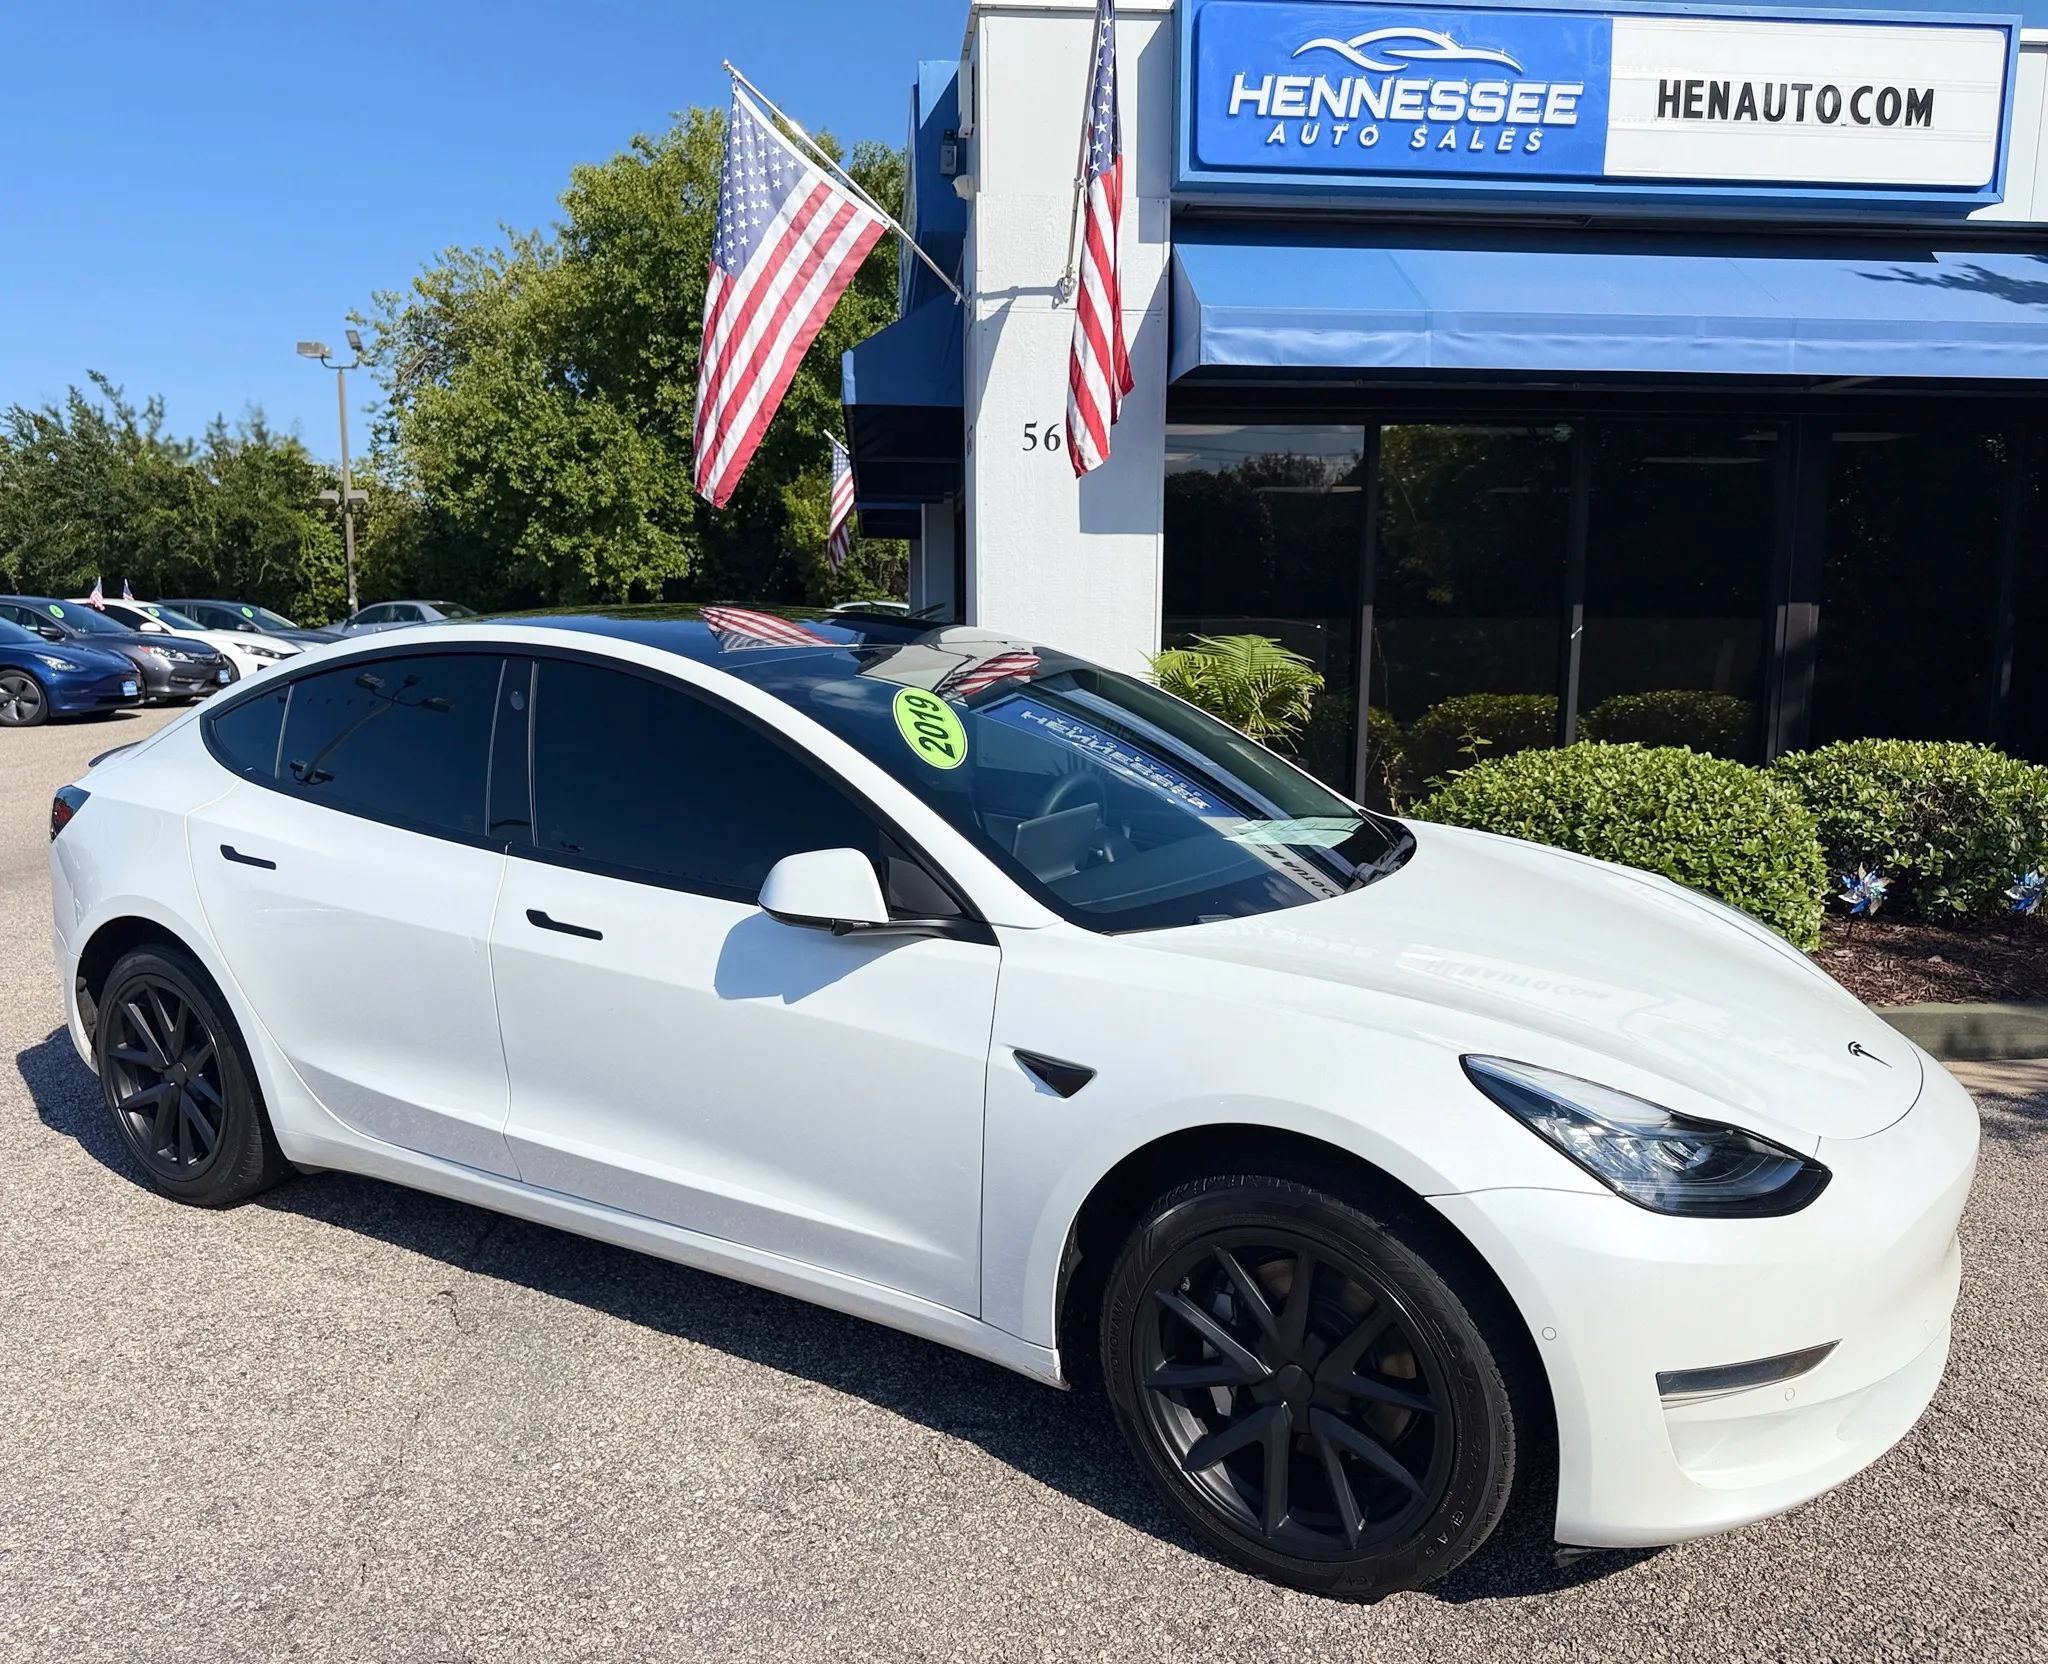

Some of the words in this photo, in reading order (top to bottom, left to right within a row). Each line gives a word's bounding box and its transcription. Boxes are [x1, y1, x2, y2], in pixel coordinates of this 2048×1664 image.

[1228, 72, 1584, 125] HENNESSEE
[1657, 79, 1935, 127] HENAUTO.COM
[1266, 121, 1380, 147] AUTO
[1410, 125, 1544, 152] SALES
[904, 694, 956, 760] 2019
